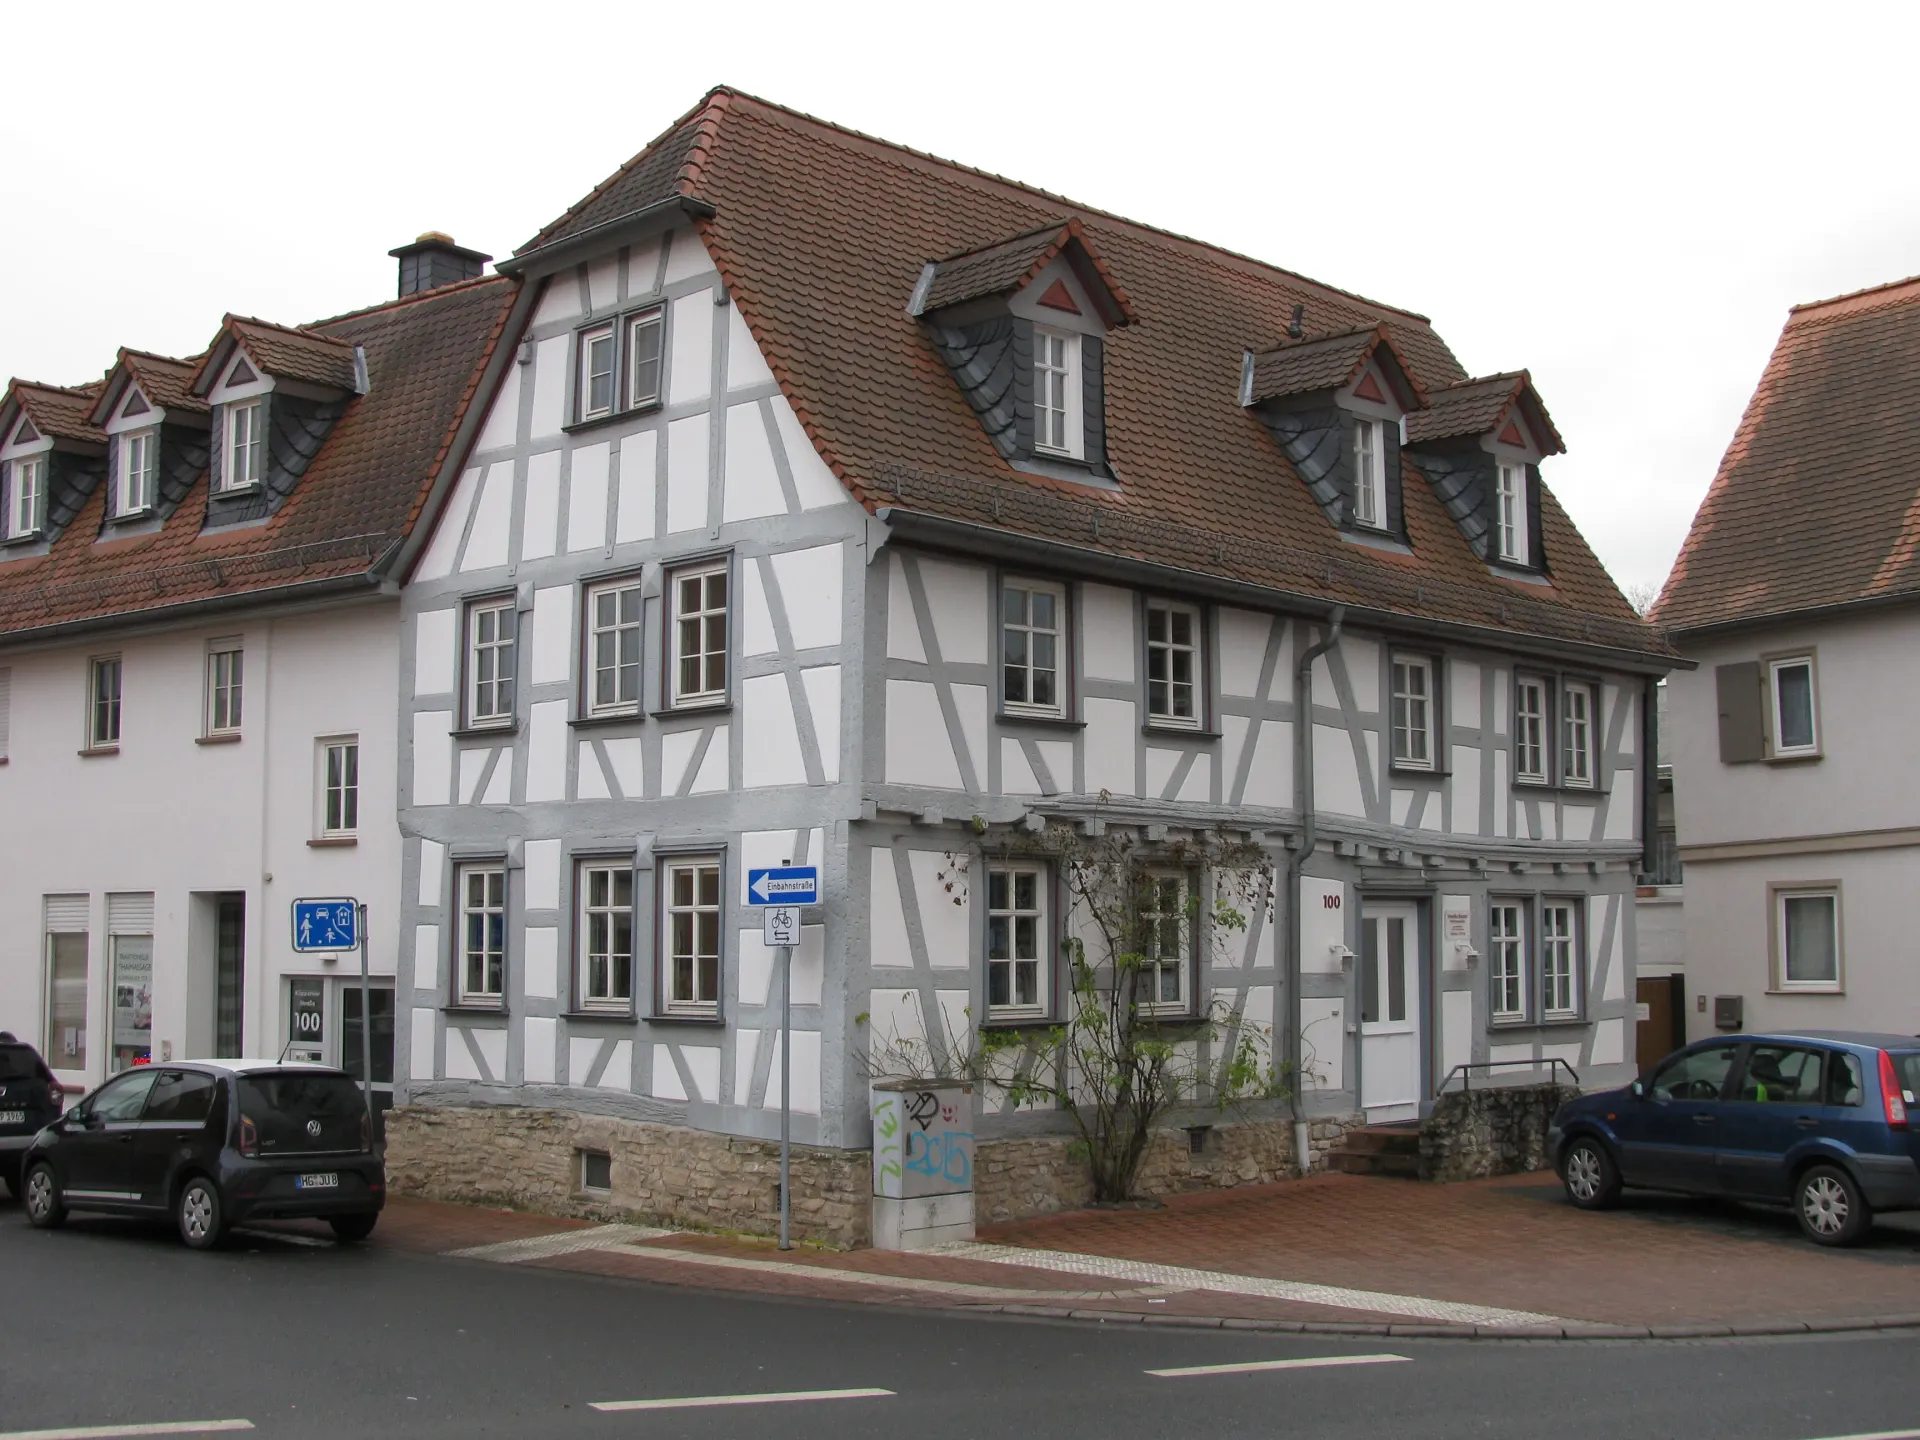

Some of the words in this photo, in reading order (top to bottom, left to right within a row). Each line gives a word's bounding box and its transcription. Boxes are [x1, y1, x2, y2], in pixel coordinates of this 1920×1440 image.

[767, 880, 813, 891] Einbahnstraße
[1322, 894, 1341, 909] 100
[294, 1011, 321, 1032] 100
[301, 1175, 314, 1187] HG
